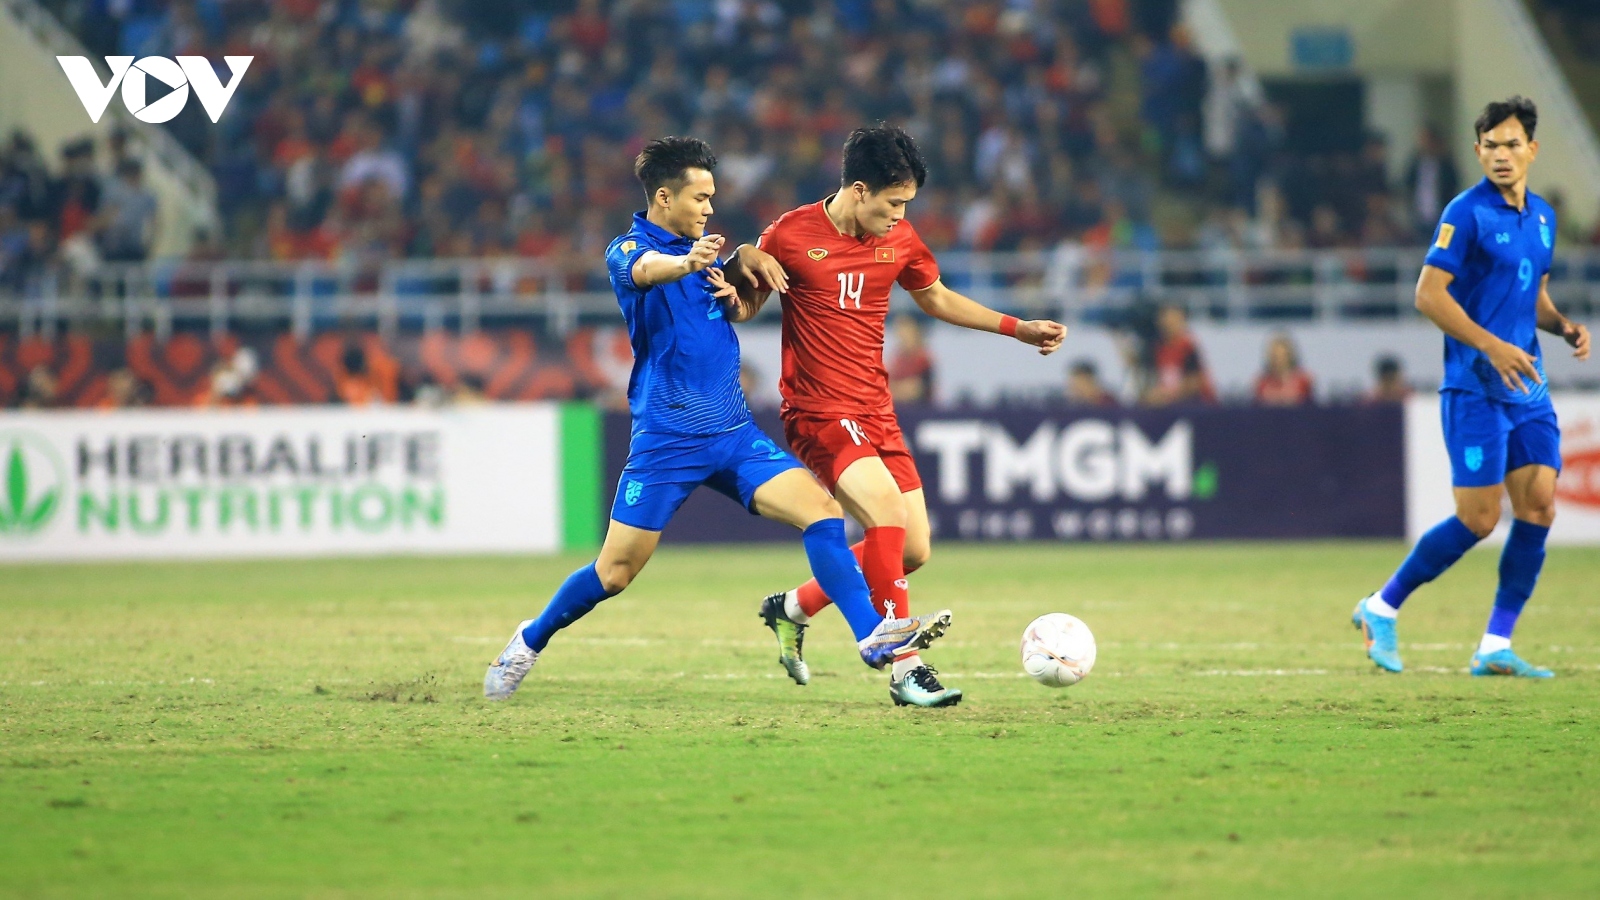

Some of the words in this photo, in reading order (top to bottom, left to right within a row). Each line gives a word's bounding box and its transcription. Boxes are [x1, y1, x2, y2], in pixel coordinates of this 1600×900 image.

[837, 272, 865, 309] 14
[1518, 258, 1533, 291] 9
[77, 431, 440, 480] HERBALIFE
[917, 418, 1194, 502] TMGM
[77, 484, 445, 533] NUTRITION
